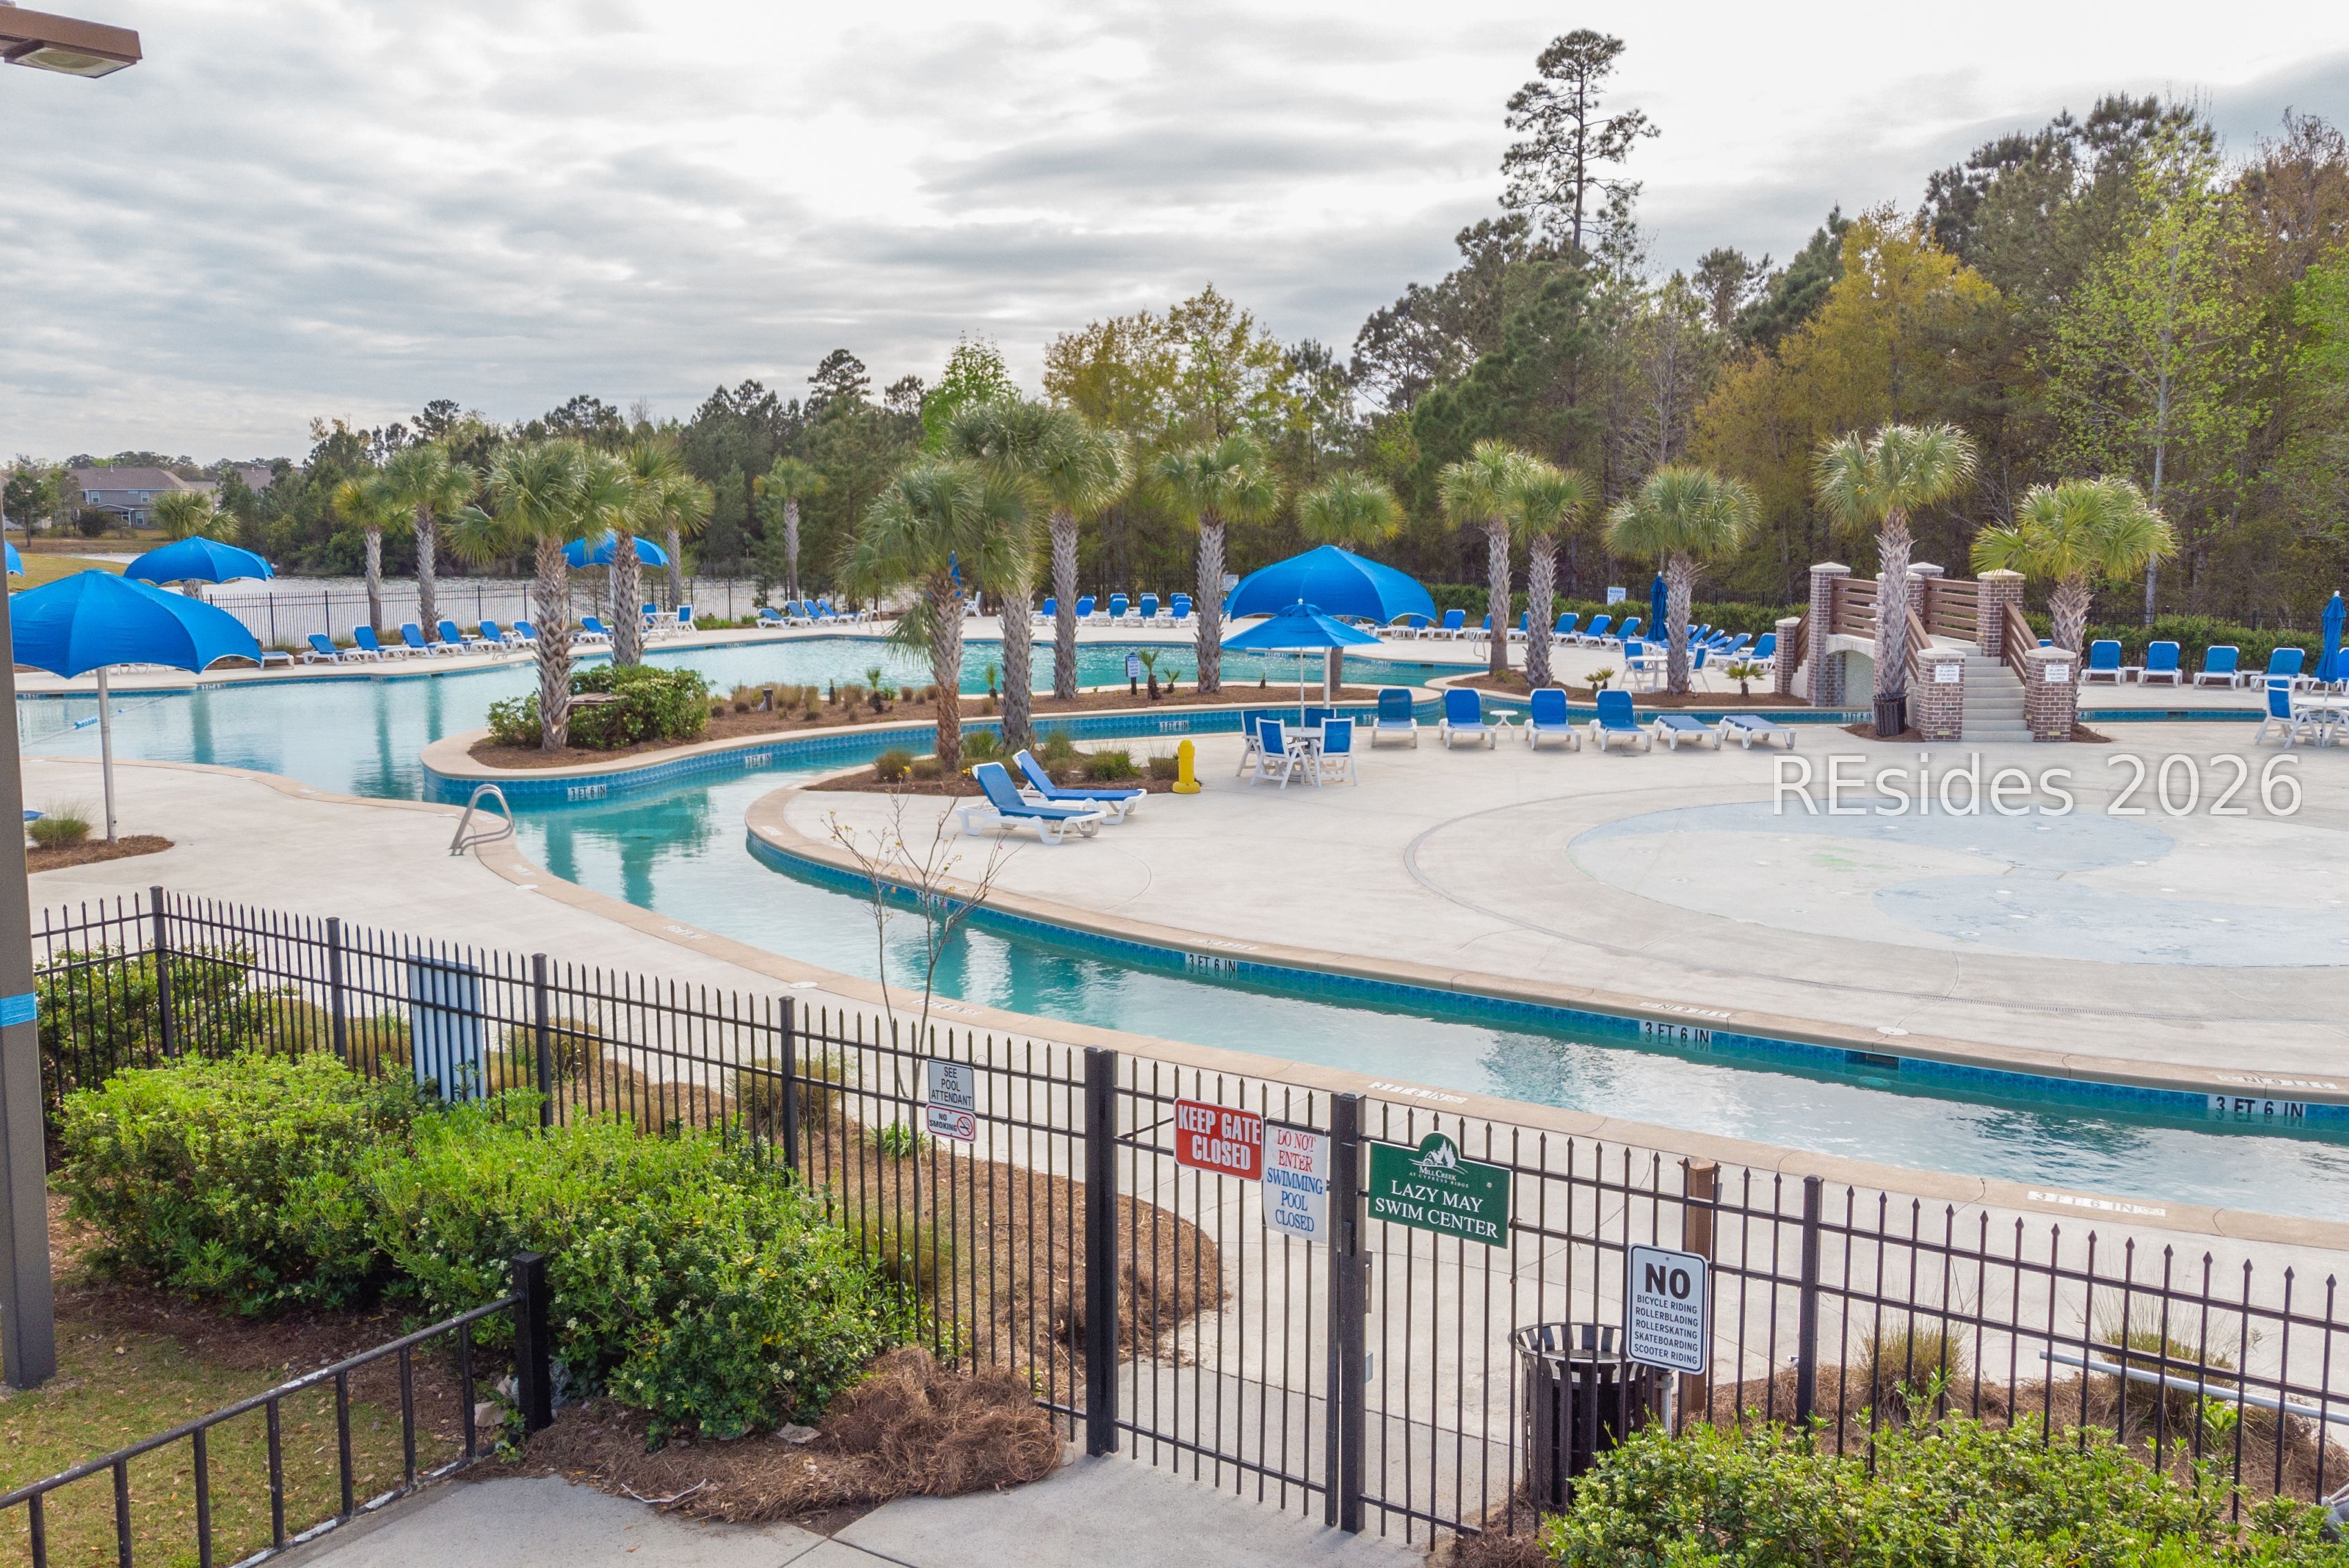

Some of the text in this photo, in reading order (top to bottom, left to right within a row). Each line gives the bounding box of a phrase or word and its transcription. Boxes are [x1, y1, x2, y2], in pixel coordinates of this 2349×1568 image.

[1181, 721, 1188, 729] IN
[598, 785, 605, 795] IN
[1189, 954, 1236, 972] 3 FT 6 IN
[1646, 1021, 1709, 1043] 3 FT 6 IN
[944, 1066, 957, 1079] SEE
[941, 1078, 961, 1092] POOL
[1426, 1091, 1446, 1100] IN
[931, 1089, 972, 1106] ATTENDANT
[2216, 1096, 2303, 1117] 3 FT 6 IN
[929, 1119, 957, 1132] SMOKING
[939, 1113, 948, 1121] NO
[1178, 1104, 1261, 1145] KEEP GATE
[1277, 1129, 1316, 1153] DO NOT
[1192, 1135, 1251, 1170] CLOSED
[1278, 1150, 1313, 1173] ENTER
[1267, 1167, 1323, 1195] SWIMMING
[1419, 1174, 1448, 1184] CYPRESS
[1450, 1180, 1470, 1188] RIDGE
[1281, 1190, 1308, 1211] POOL
[1391, 1179, 1483, 1213] LAZY MAY
[2036, 1193, 2047, 1201] 3
[2055, 1195, 2076, 1205] FT
[2112, 1203, 2134, 1213] IN
[1275, 1209, 1314, 1232] CLOSED
[1375, 1197, 1499, 1239] SWIM CENTER
[1646, 1262, 1691, 1300] NO
[1637, 1295, 1697, 1314] BICYCLE RIDING
[1635, 1306, 1698, 1327] ROLLERBLADING
[1636, 1319, 1697, 1340] ROLLERSKATING
[1635, 1331, 1698, 1352] SKATEBOARDING
[1635, 1343, 1697, 1364] SCOOTER RIDING
